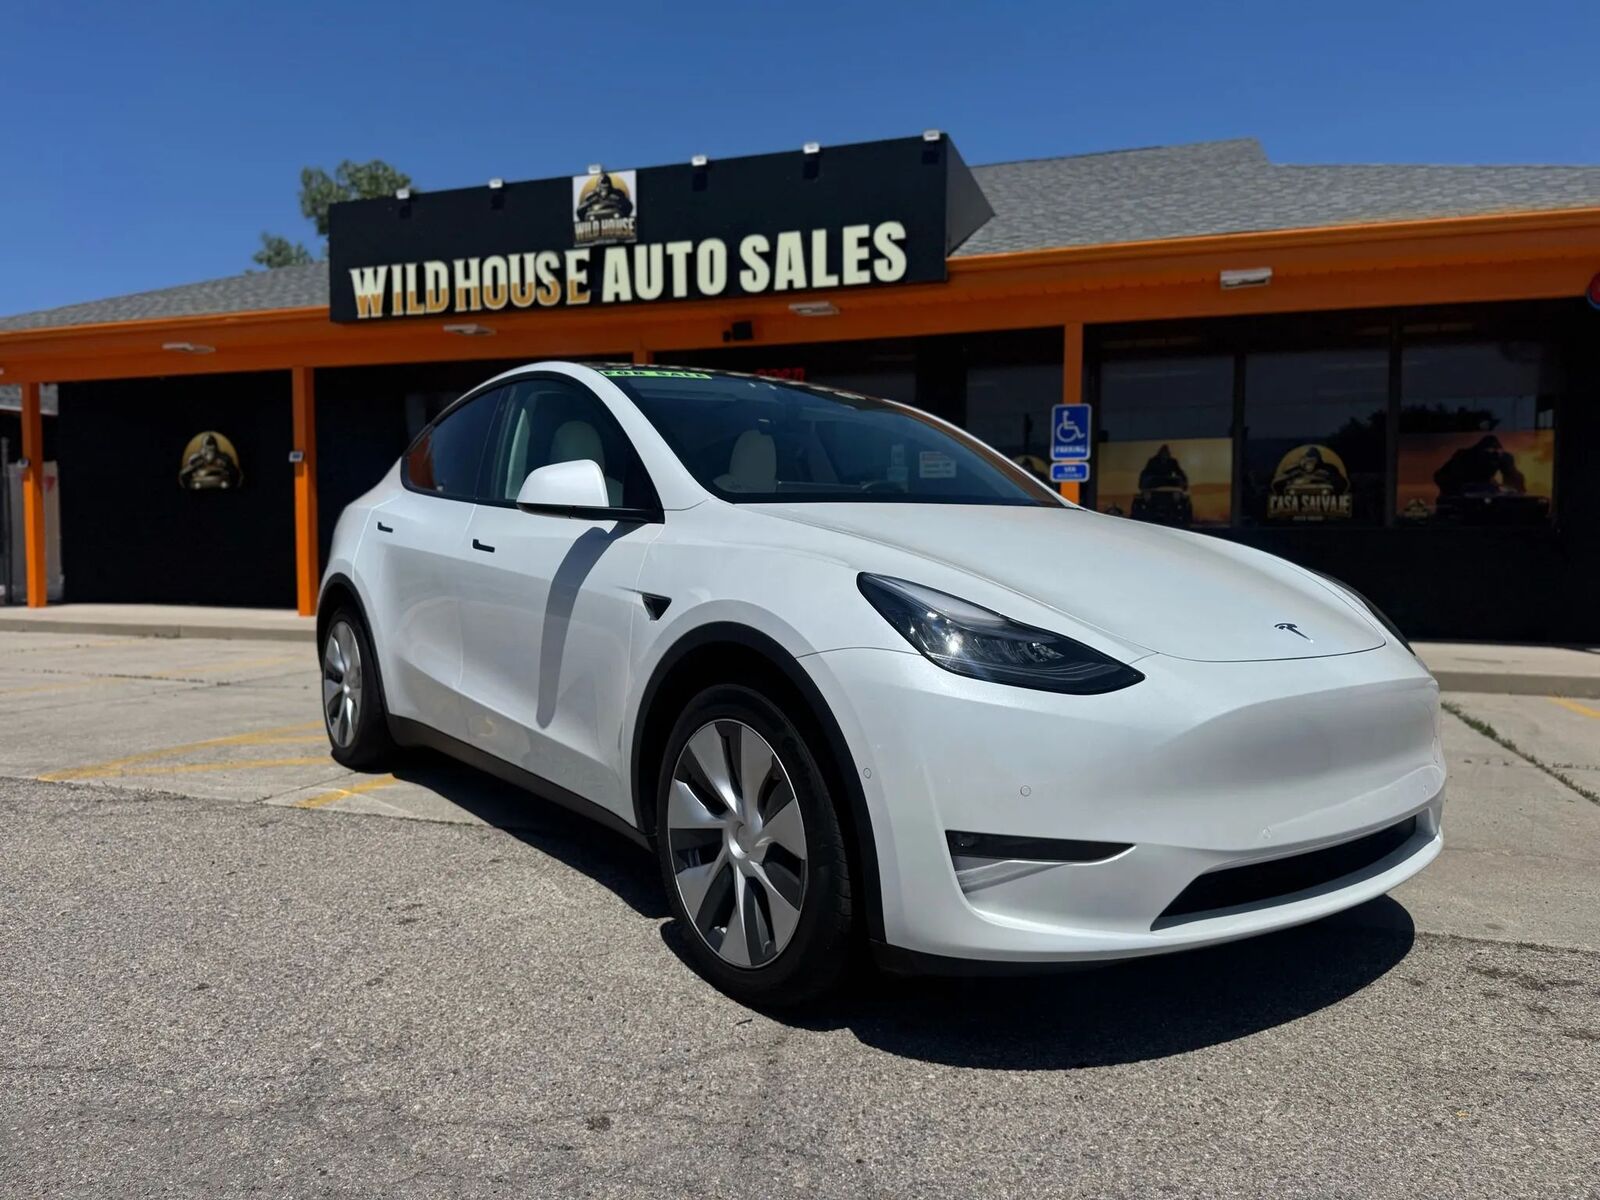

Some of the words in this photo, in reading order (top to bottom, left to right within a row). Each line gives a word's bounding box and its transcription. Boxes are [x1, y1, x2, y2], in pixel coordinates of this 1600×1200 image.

[574, 220, 600, 240] WILD
[601, 217, 635, 236] HOUSE
[602, 238, 727, 302] AUTO
[739, 221, 907, 293] SALES
